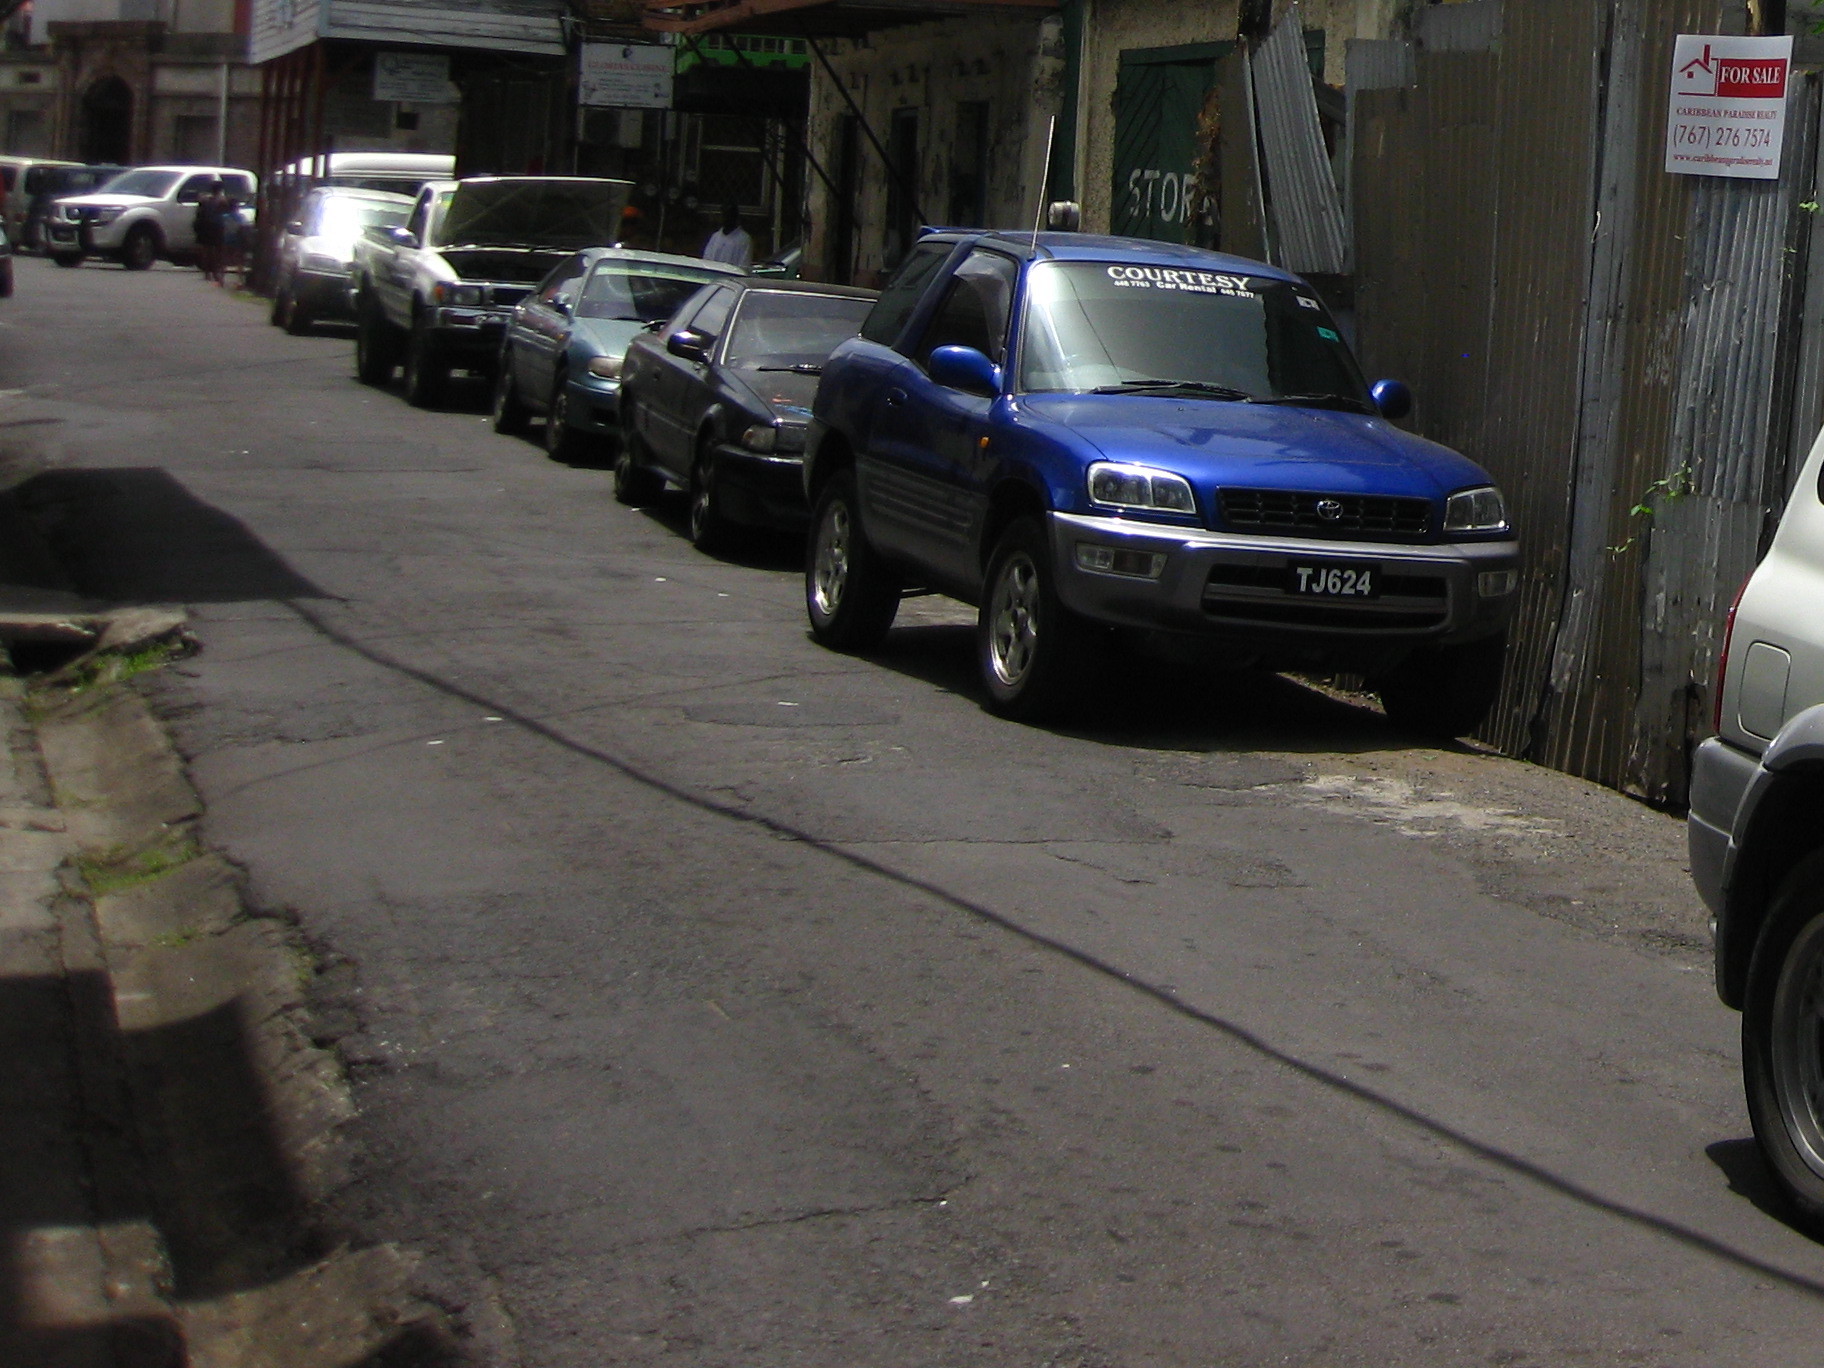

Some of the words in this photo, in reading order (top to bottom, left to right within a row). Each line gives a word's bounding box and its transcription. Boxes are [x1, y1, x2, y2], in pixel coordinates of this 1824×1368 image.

[1720, 66, 1750, 83] FOR
[1752, 66, 1781, 84] SALE
[1676, 107, 1722, 118] CARIBBEAN
[1673, 124, 1711, 149] (767)
[1715, 127, 1740, 147] 276
[1743, 128, 1771, 148] 7574
[1107, 266, 1251, 290] COURTESY
[1156, 282, 1177, 290] Car
[1179, 282, 1217, 294] Rental
[1296, 567, 1371, 595] TJ624
